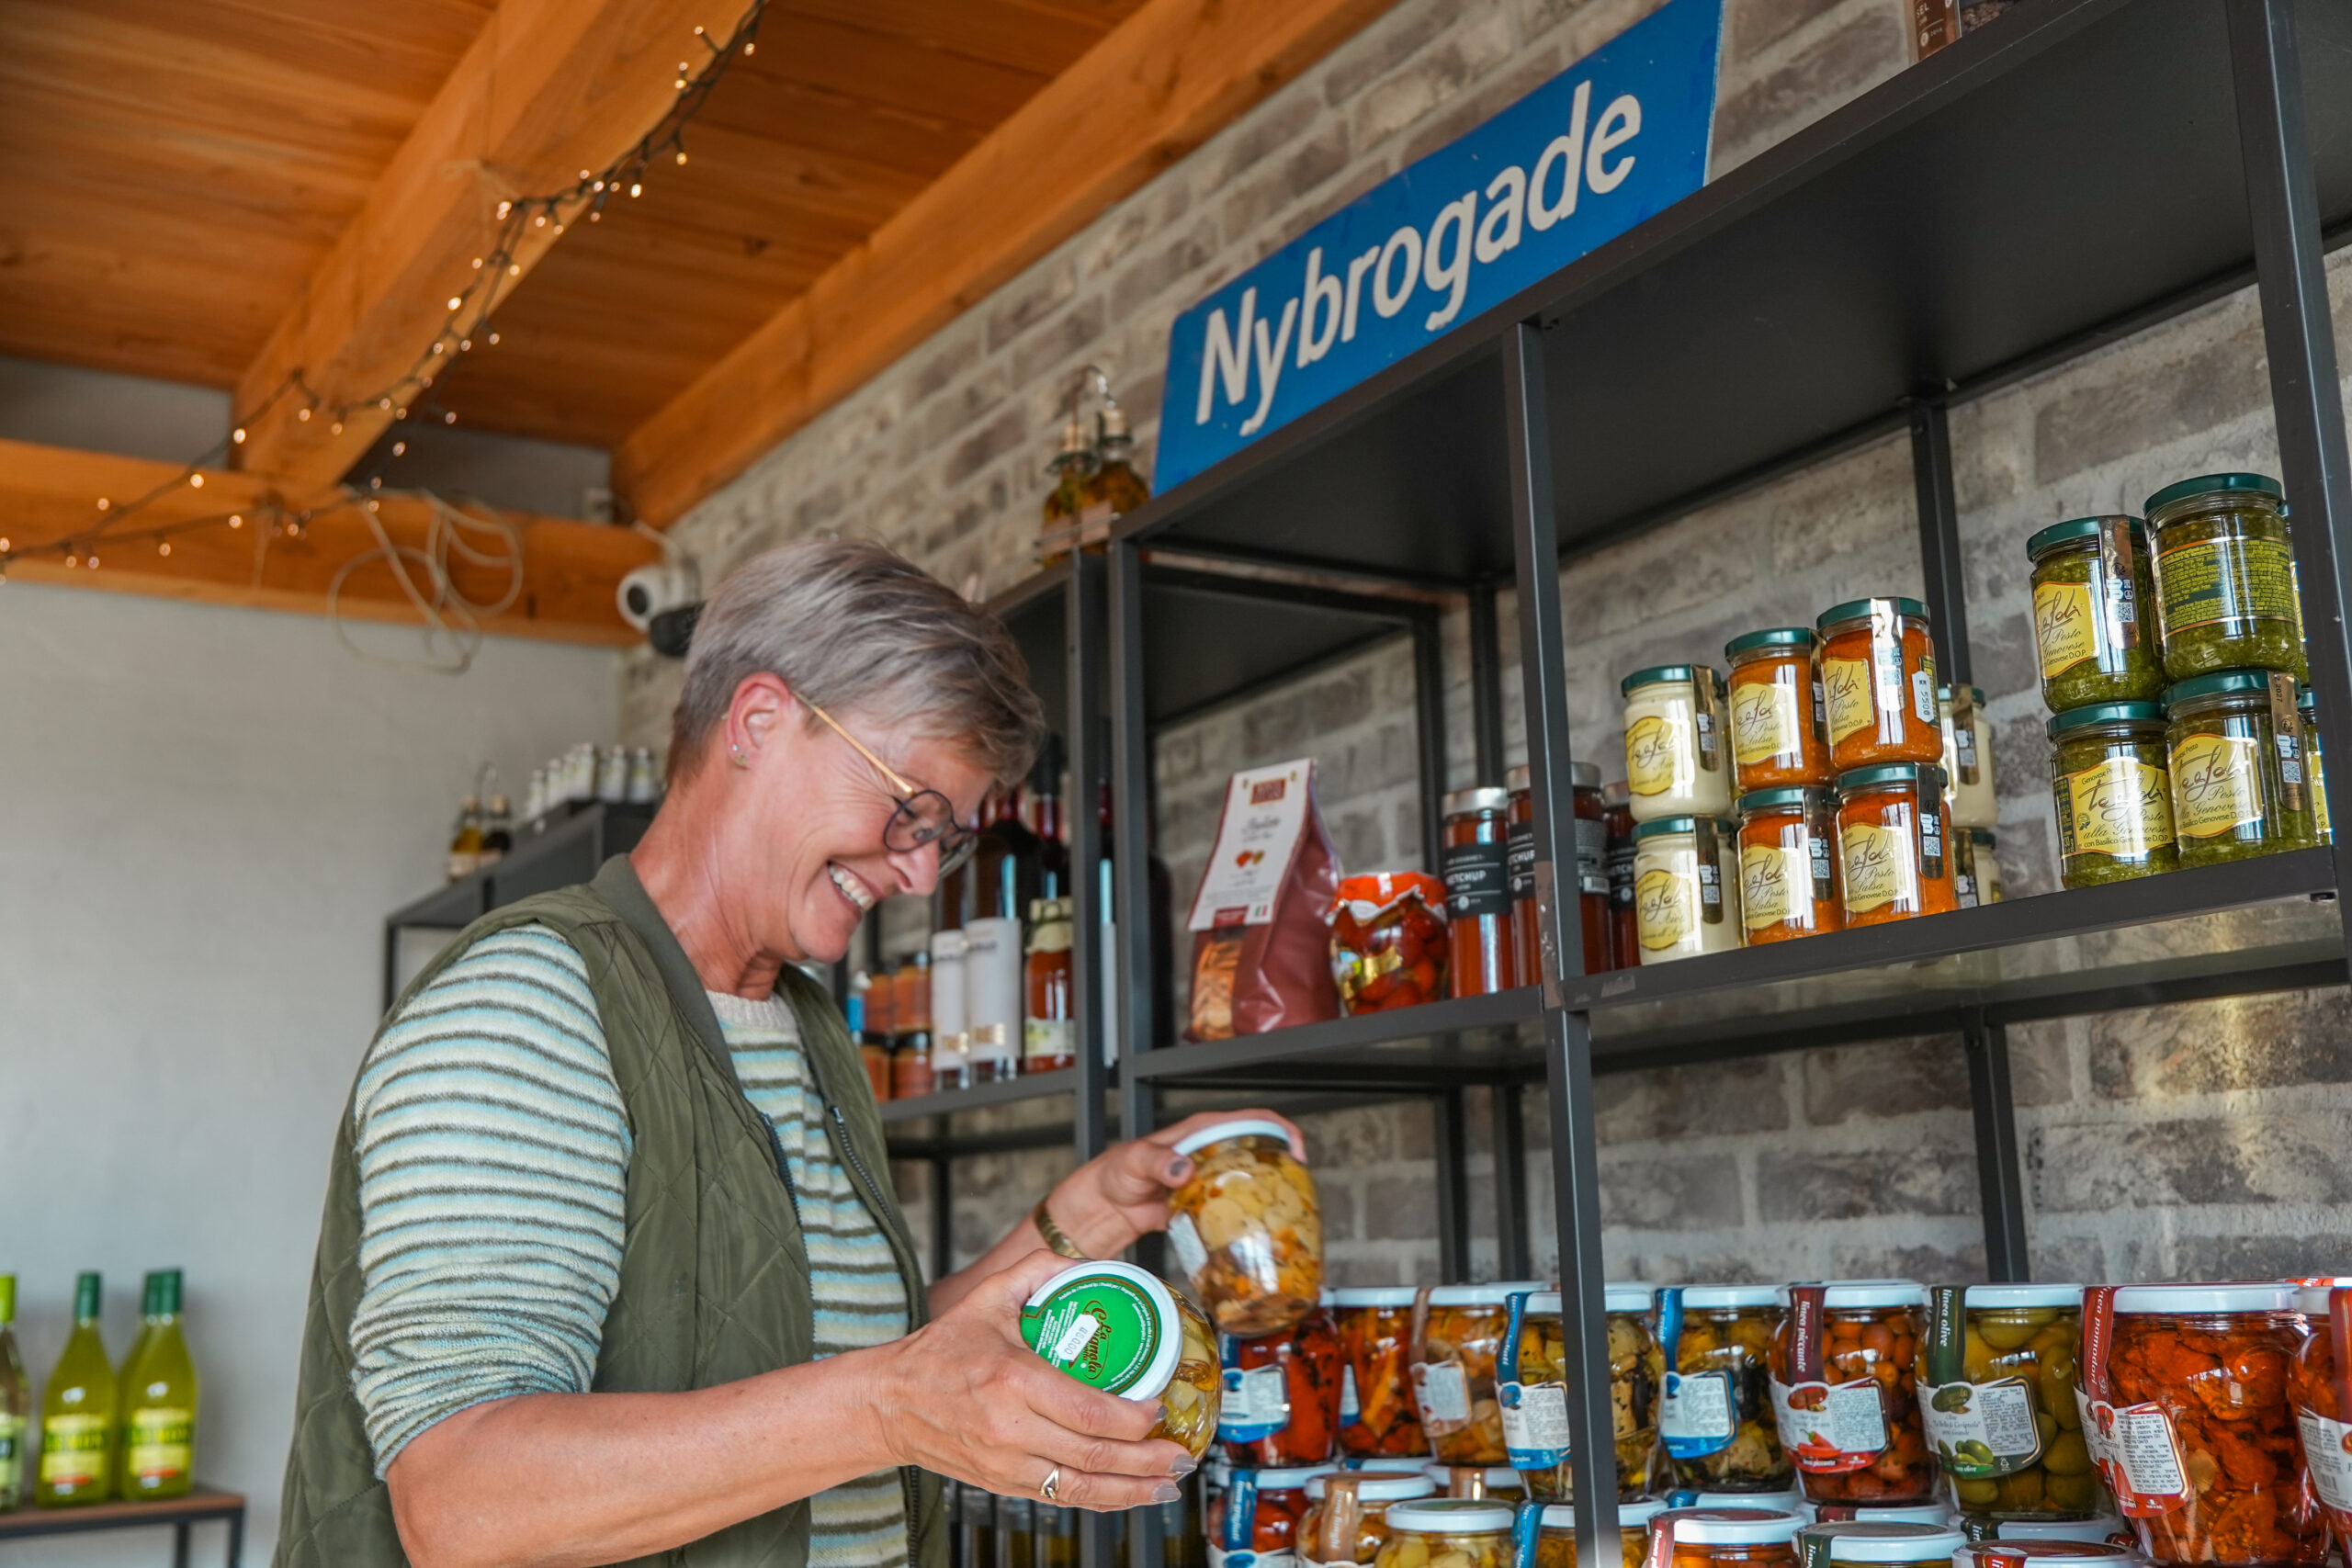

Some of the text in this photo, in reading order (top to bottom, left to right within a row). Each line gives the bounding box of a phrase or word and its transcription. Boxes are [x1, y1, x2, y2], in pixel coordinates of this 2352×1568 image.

[1195, 80, 1642, 437] Nybrogade
[2052, 628, 2081, 643] Pesto
[1797, 1301, 1811, 1372] linea piccante
[1939, 1289, 1952, 1348] linea olive
[2091, 1316, 2101, 1385] pomodori
